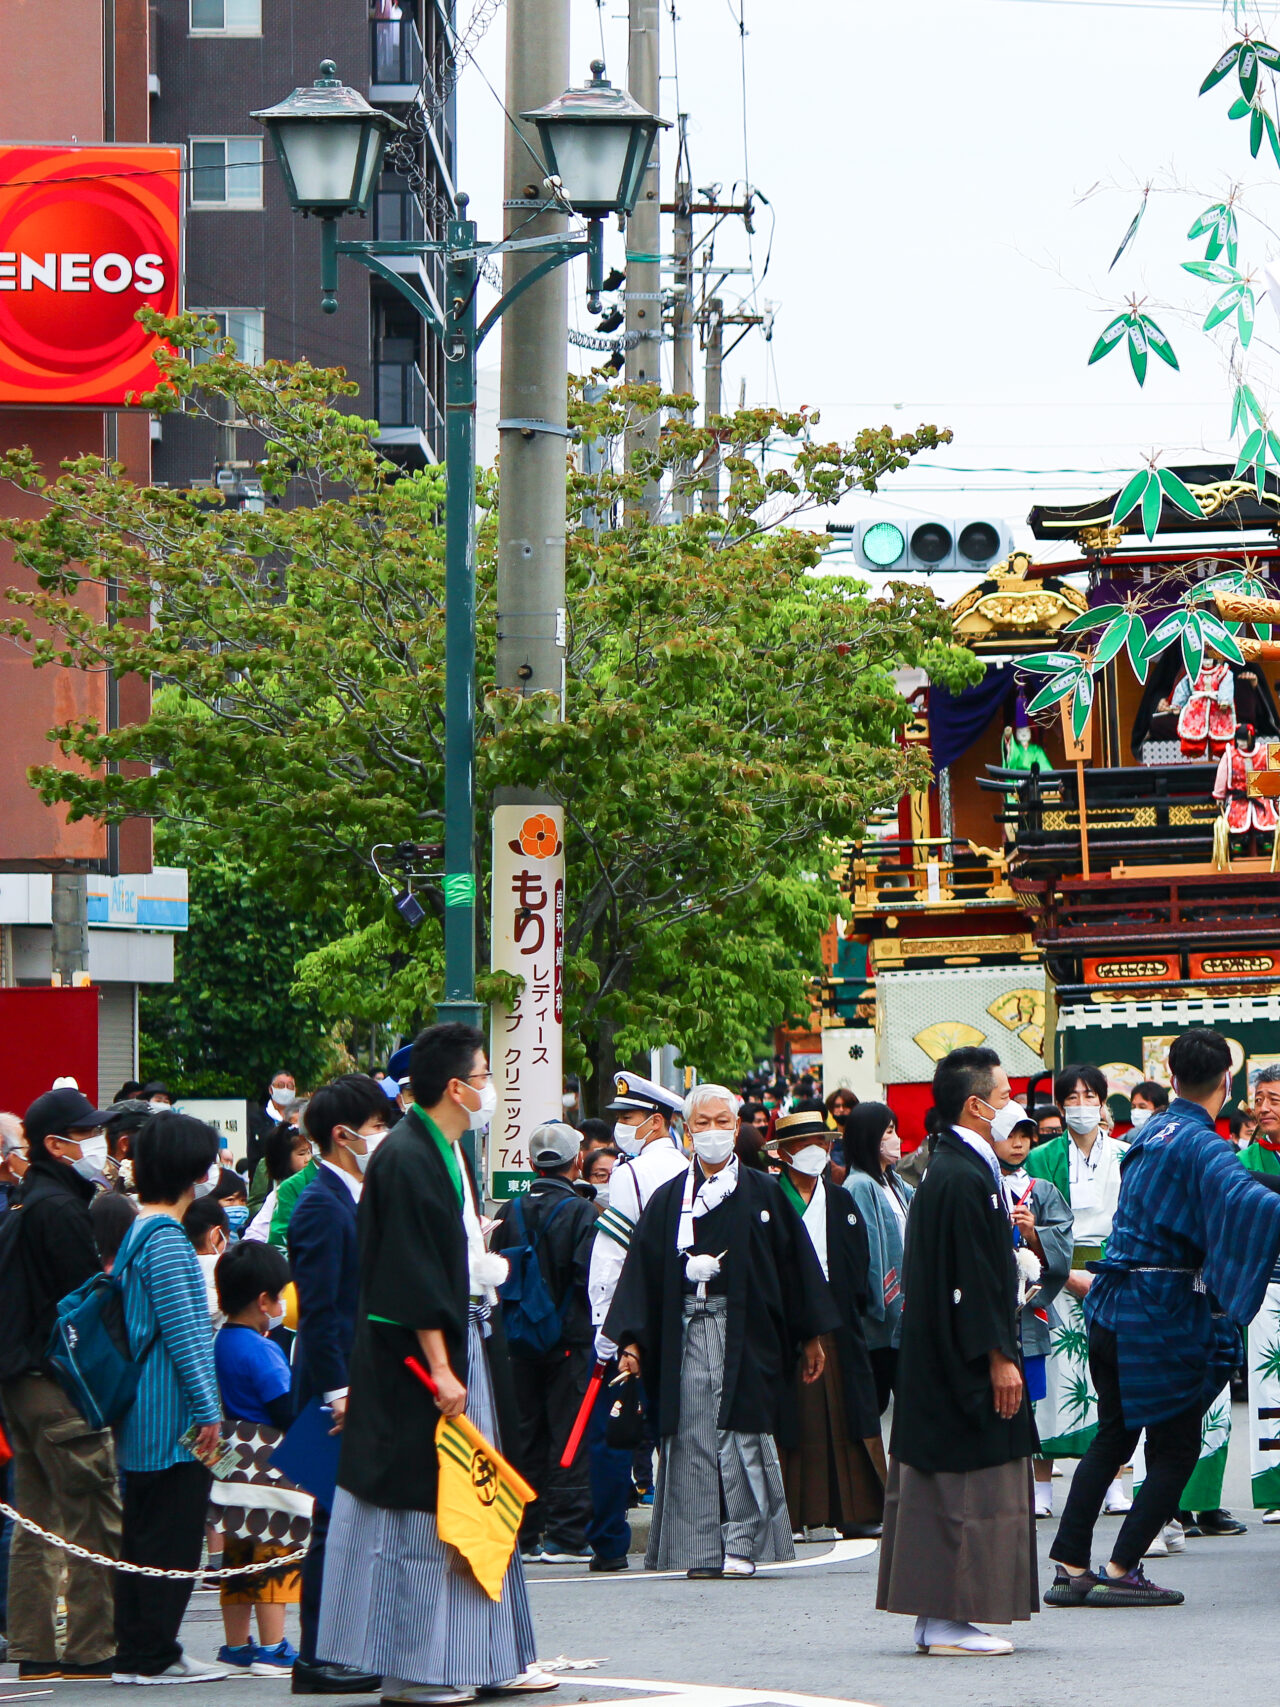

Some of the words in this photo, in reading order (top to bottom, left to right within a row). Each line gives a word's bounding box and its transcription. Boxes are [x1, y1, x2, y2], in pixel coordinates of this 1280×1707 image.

[0, 252, 165, 294] ENEOS
[112, 880, 135, 913] Aflac
[511, 869, 547, 955] もり
[531, 964, 550, 1065] レディース
[503, 1048, 522, 1141] クリニック
